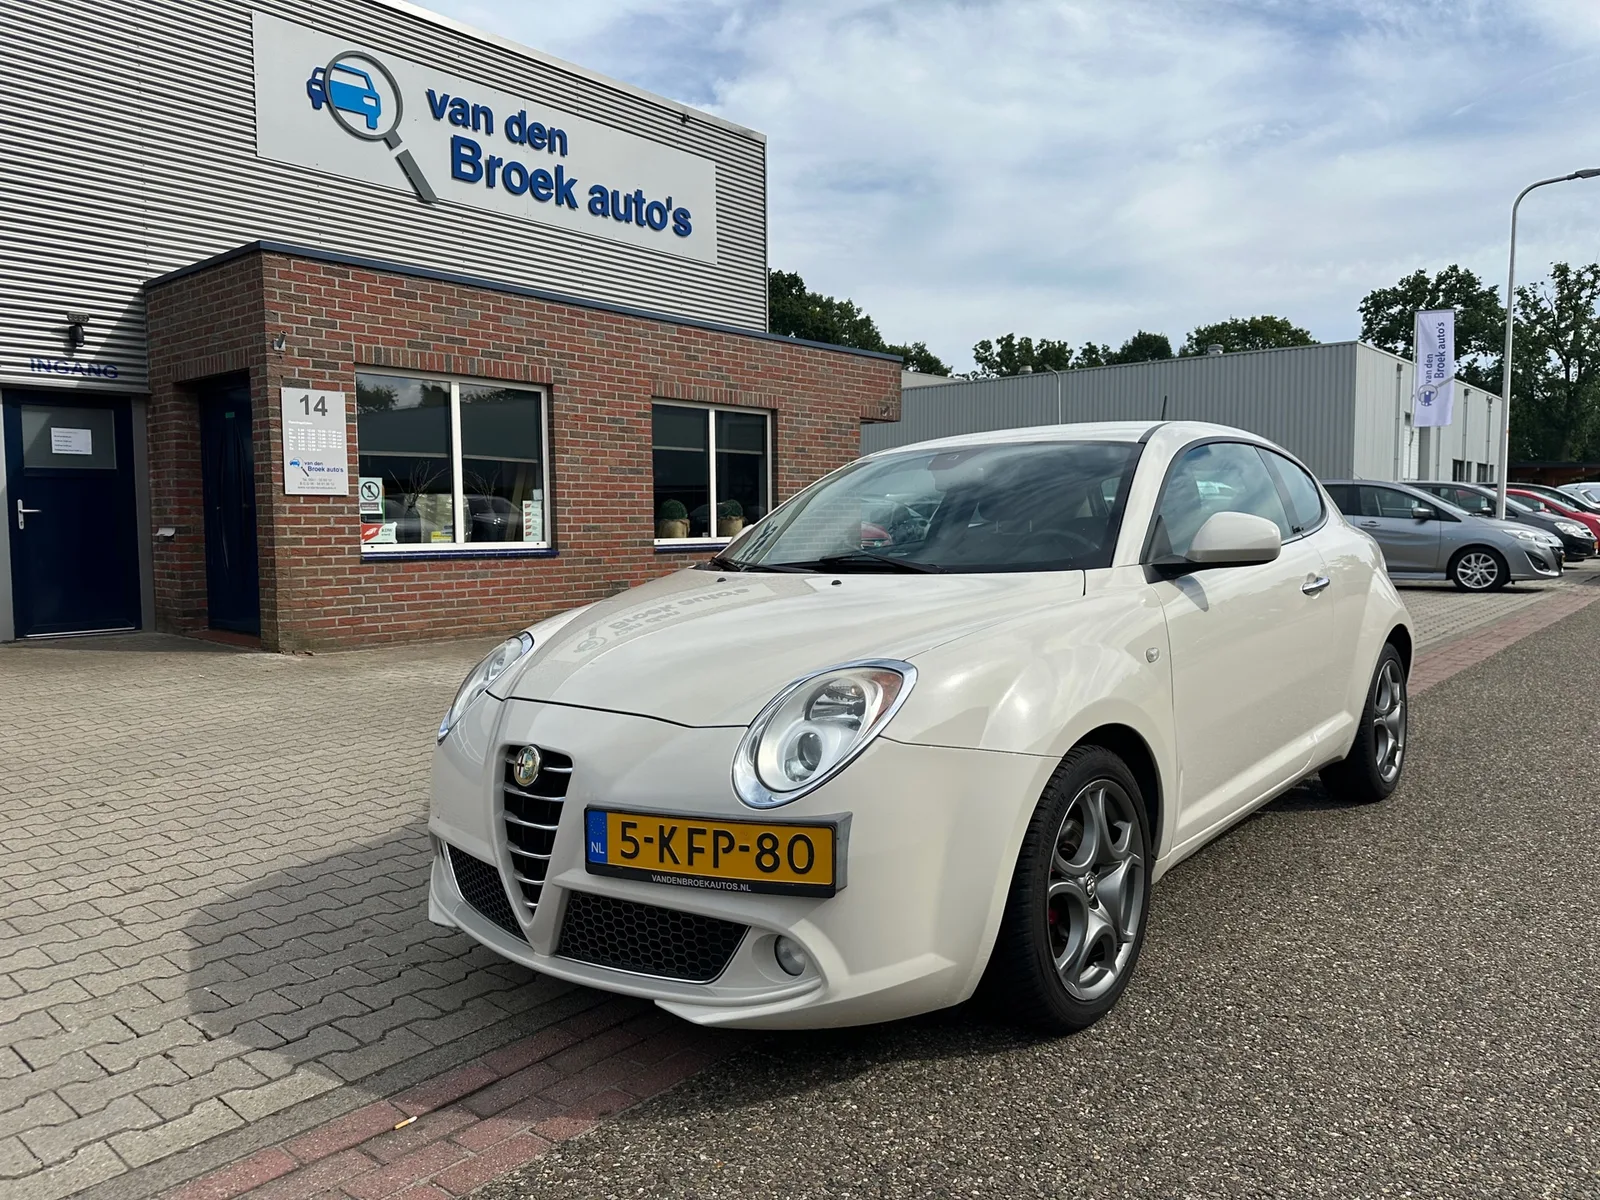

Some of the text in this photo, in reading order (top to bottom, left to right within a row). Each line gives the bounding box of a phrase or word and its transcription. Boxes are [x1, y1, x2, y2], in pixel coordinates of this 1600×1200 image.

[427, 88, 568, 156] van den
[451, 134, 693, 237] Broek auto's
[1434, 322, 1445, 378] Broek auto's
[30, 358, 119, 378] INGANG
[1424, 353, 1433, 369] den
[299, 394, 328, 416] 14
[307, 465, 325, 473] Broek
[591, 841, 605, 854] NL
[620, 821, 815, 875] 5-KFP-80
[651, 874, 752, 892] VANDENBROEKAUTOS.NL
